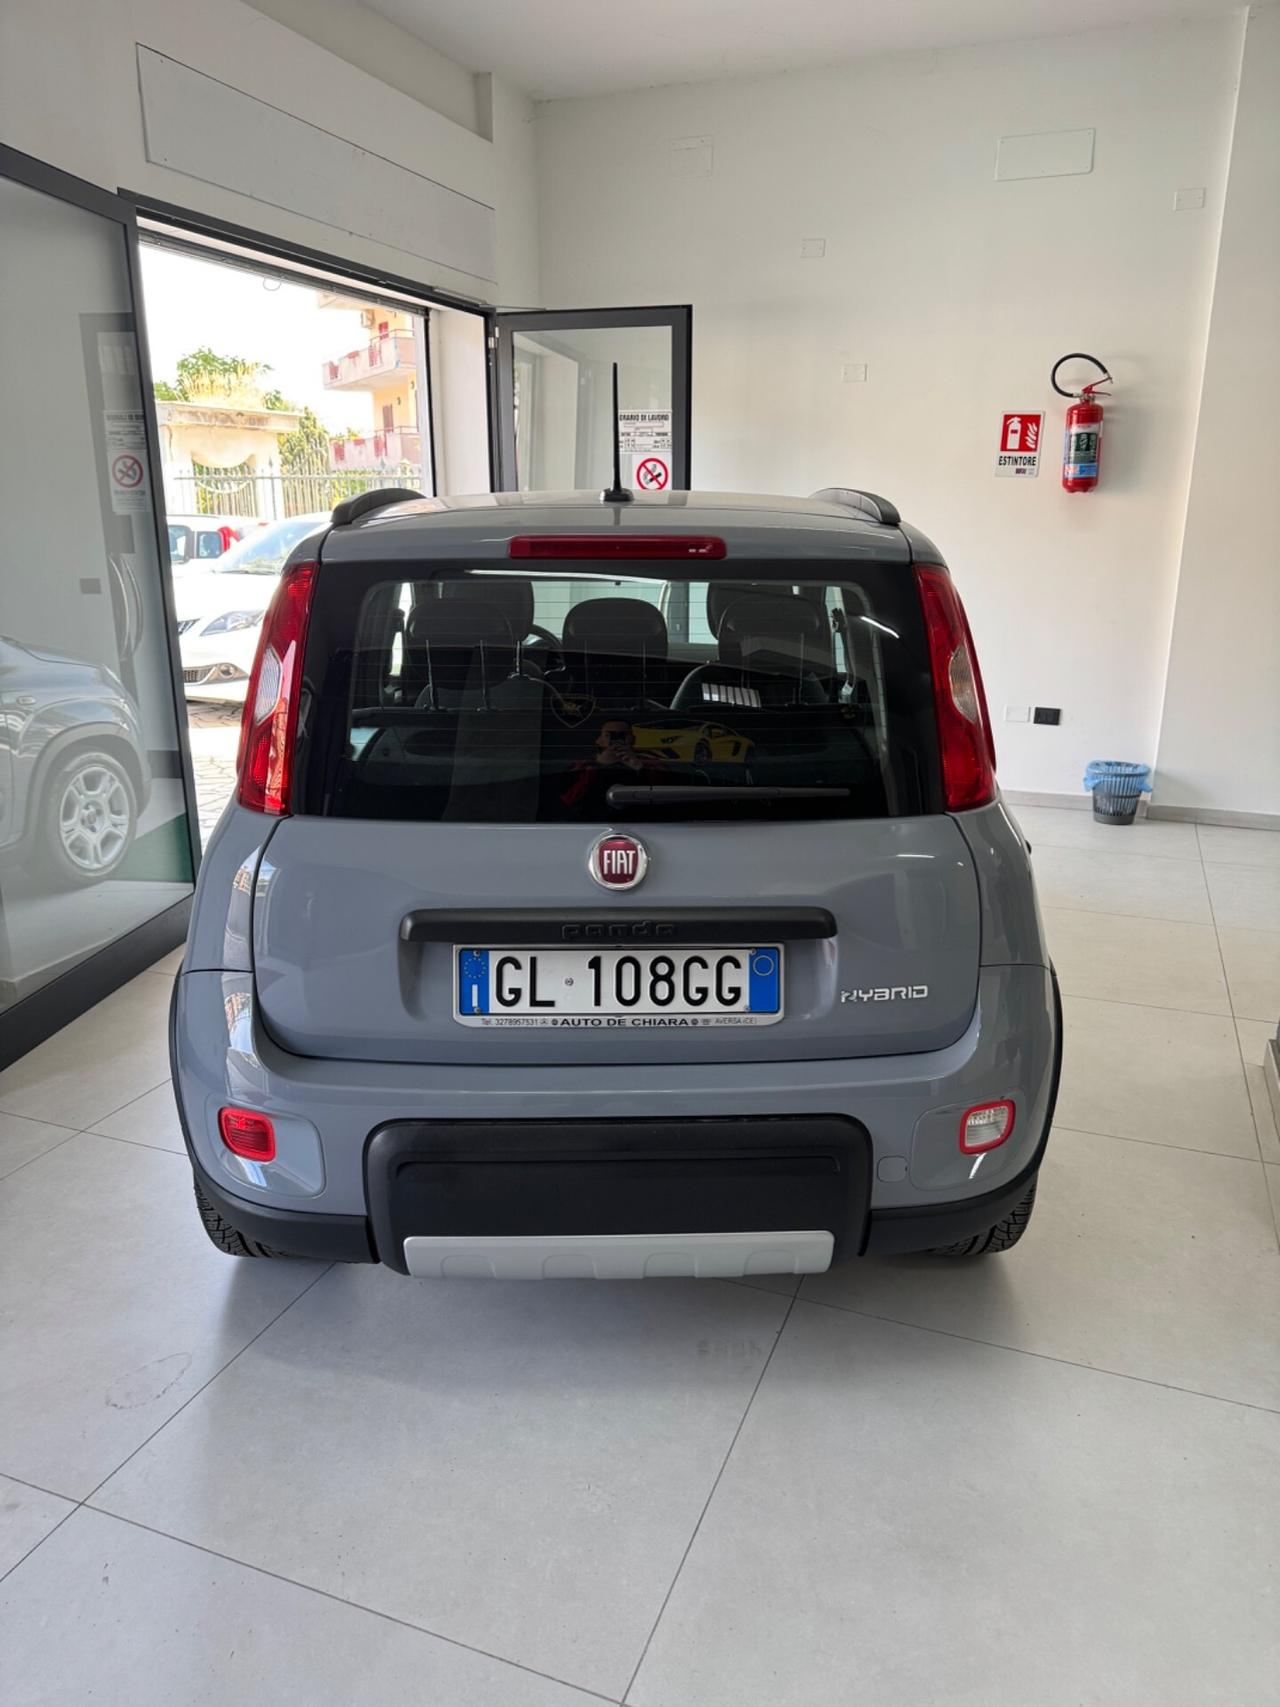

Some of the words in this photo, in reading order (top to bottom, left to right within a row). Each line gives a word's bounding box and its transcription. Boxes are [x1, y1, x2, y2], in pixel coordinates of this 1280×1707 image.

[998, 455, 1037, 467] ESTINTORE
[603, 849, 636, 875] FIAT
[495, 955, 555, 1008] GL
[588, 955, 742, 1008] 108GG
[841, 985, 929, 1003] HYBRID
[559, 1018, 602, 1027] AUTO
[607, 1018, 627, 1027] DE
[631, 1018, 689, 1027] CHIARA
